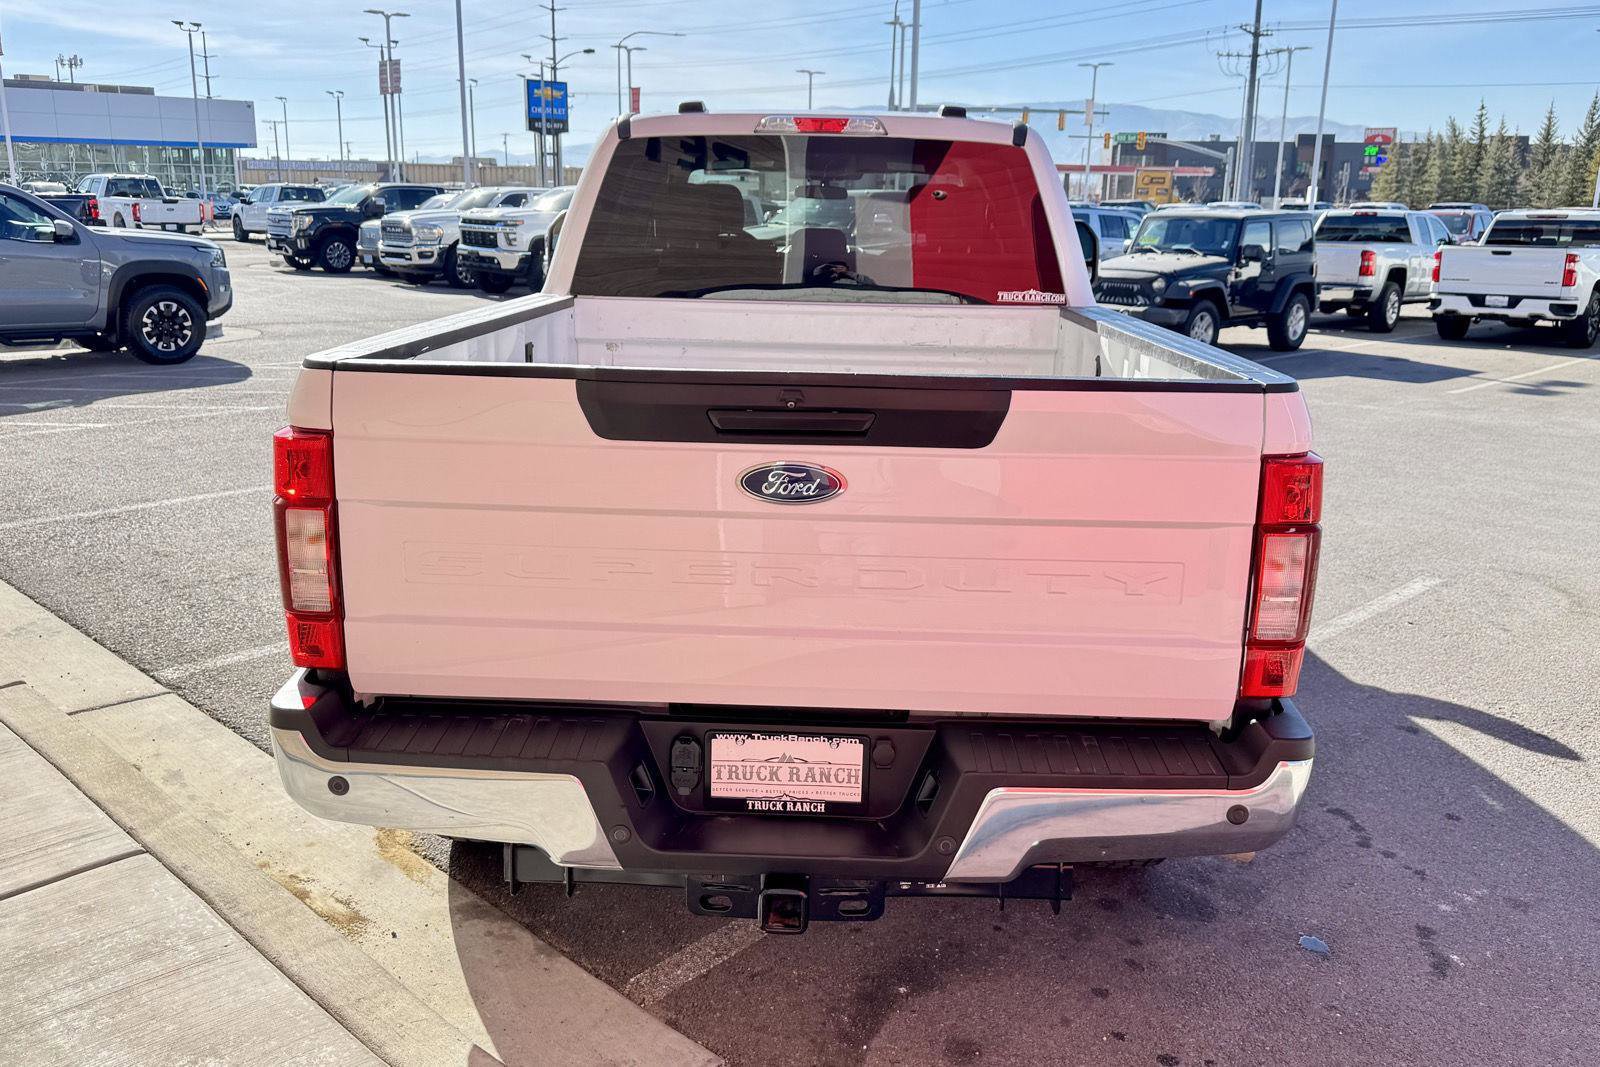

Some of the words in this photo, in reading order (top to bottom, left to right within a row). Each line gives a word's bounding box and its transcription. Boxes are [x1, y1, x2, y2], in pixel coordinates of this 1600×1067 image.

[762, 470, 820, 496] Ford
[420, 550, 819, 590] SUPER
[853, 564, 1169, 598] DUTY
[715, 733, 860, 745] www.TruckRanch.com
[712, 764, 783, 782] TRUCK
[787, 765, 861, 785] RANCH
[746, 800, 784, 811] TRUCK
[786, 801, 825, 813] RANCH
